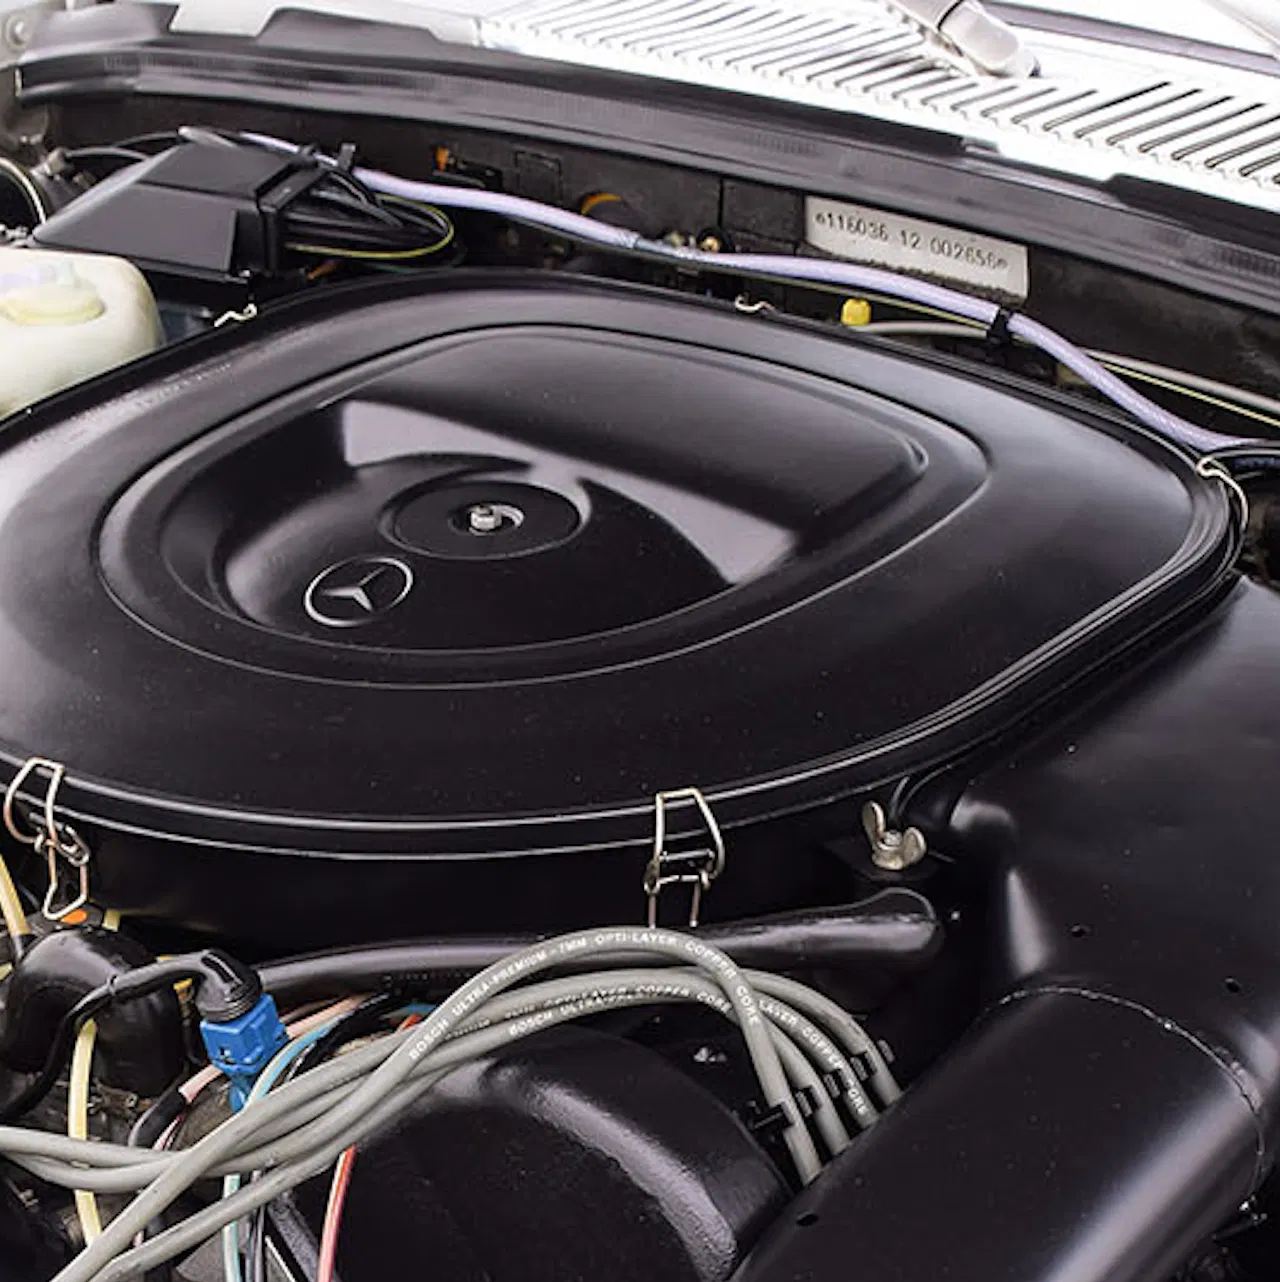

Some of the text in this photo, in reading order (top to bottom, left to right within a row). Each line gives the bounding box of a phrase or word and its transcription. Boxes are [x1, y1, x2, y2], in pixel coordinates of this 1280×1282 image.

[899, 229, 923, 250] 12
[408, 1018, 450, 1061] BOSCH
[685, 941, 738, 981] COPPER
[735, 985, 762, 1026] CORE
[508, 1011, 554, 1037] BOSCH
